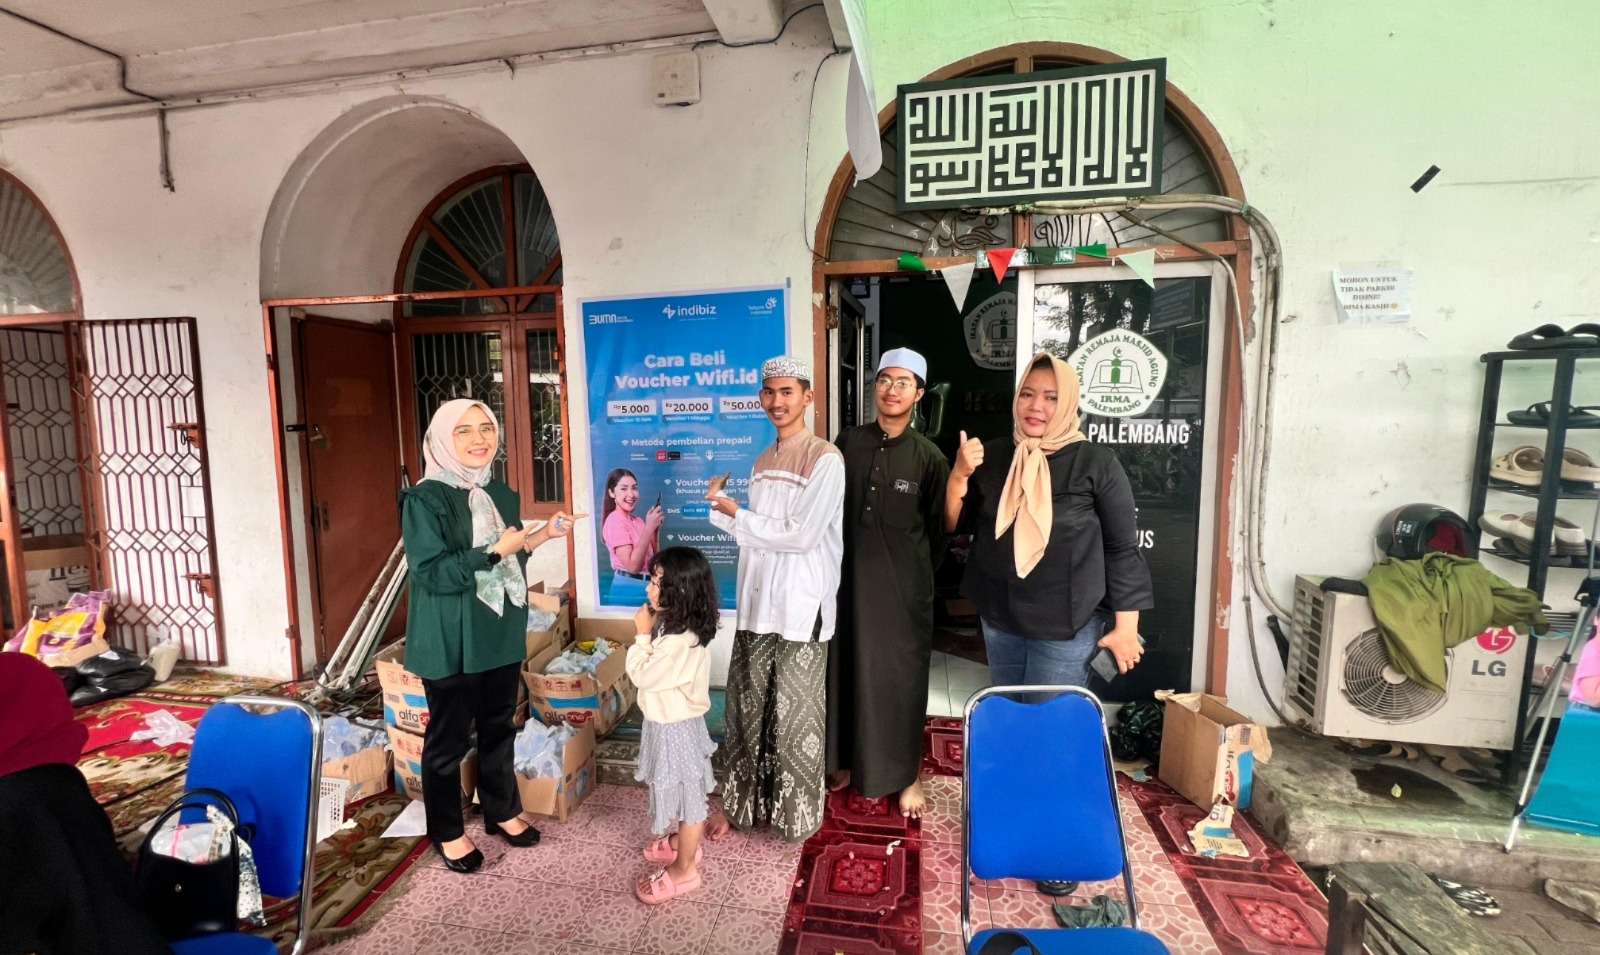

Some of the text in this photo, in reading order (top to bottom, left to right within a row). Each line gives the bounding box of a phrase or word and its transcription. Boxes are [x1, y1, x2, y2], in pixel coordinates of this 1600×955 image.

[677, 304, 717, 316] indibiz
[644, 350, 726, 368] Cara Beli
[1086, 334, 1121, 356] REMAJA
[1122, 334, 1153, 358] MASJID
[1147, 357, 1160, 388] AGUNG
[615, 368, 758, 389] Voucher Wifi.id
[1087, 398, 1142, 414] PALEMBANG
[1100, 395, 1131, 404] IRMA
[631, 436, 752, 447] Metode pembelian prepaid
[1088, 423, 1190, 444] PALEMBANG
[678, 534, 736, 542] Voucher Wifi
[1471, 659, 1507, 677] LG
